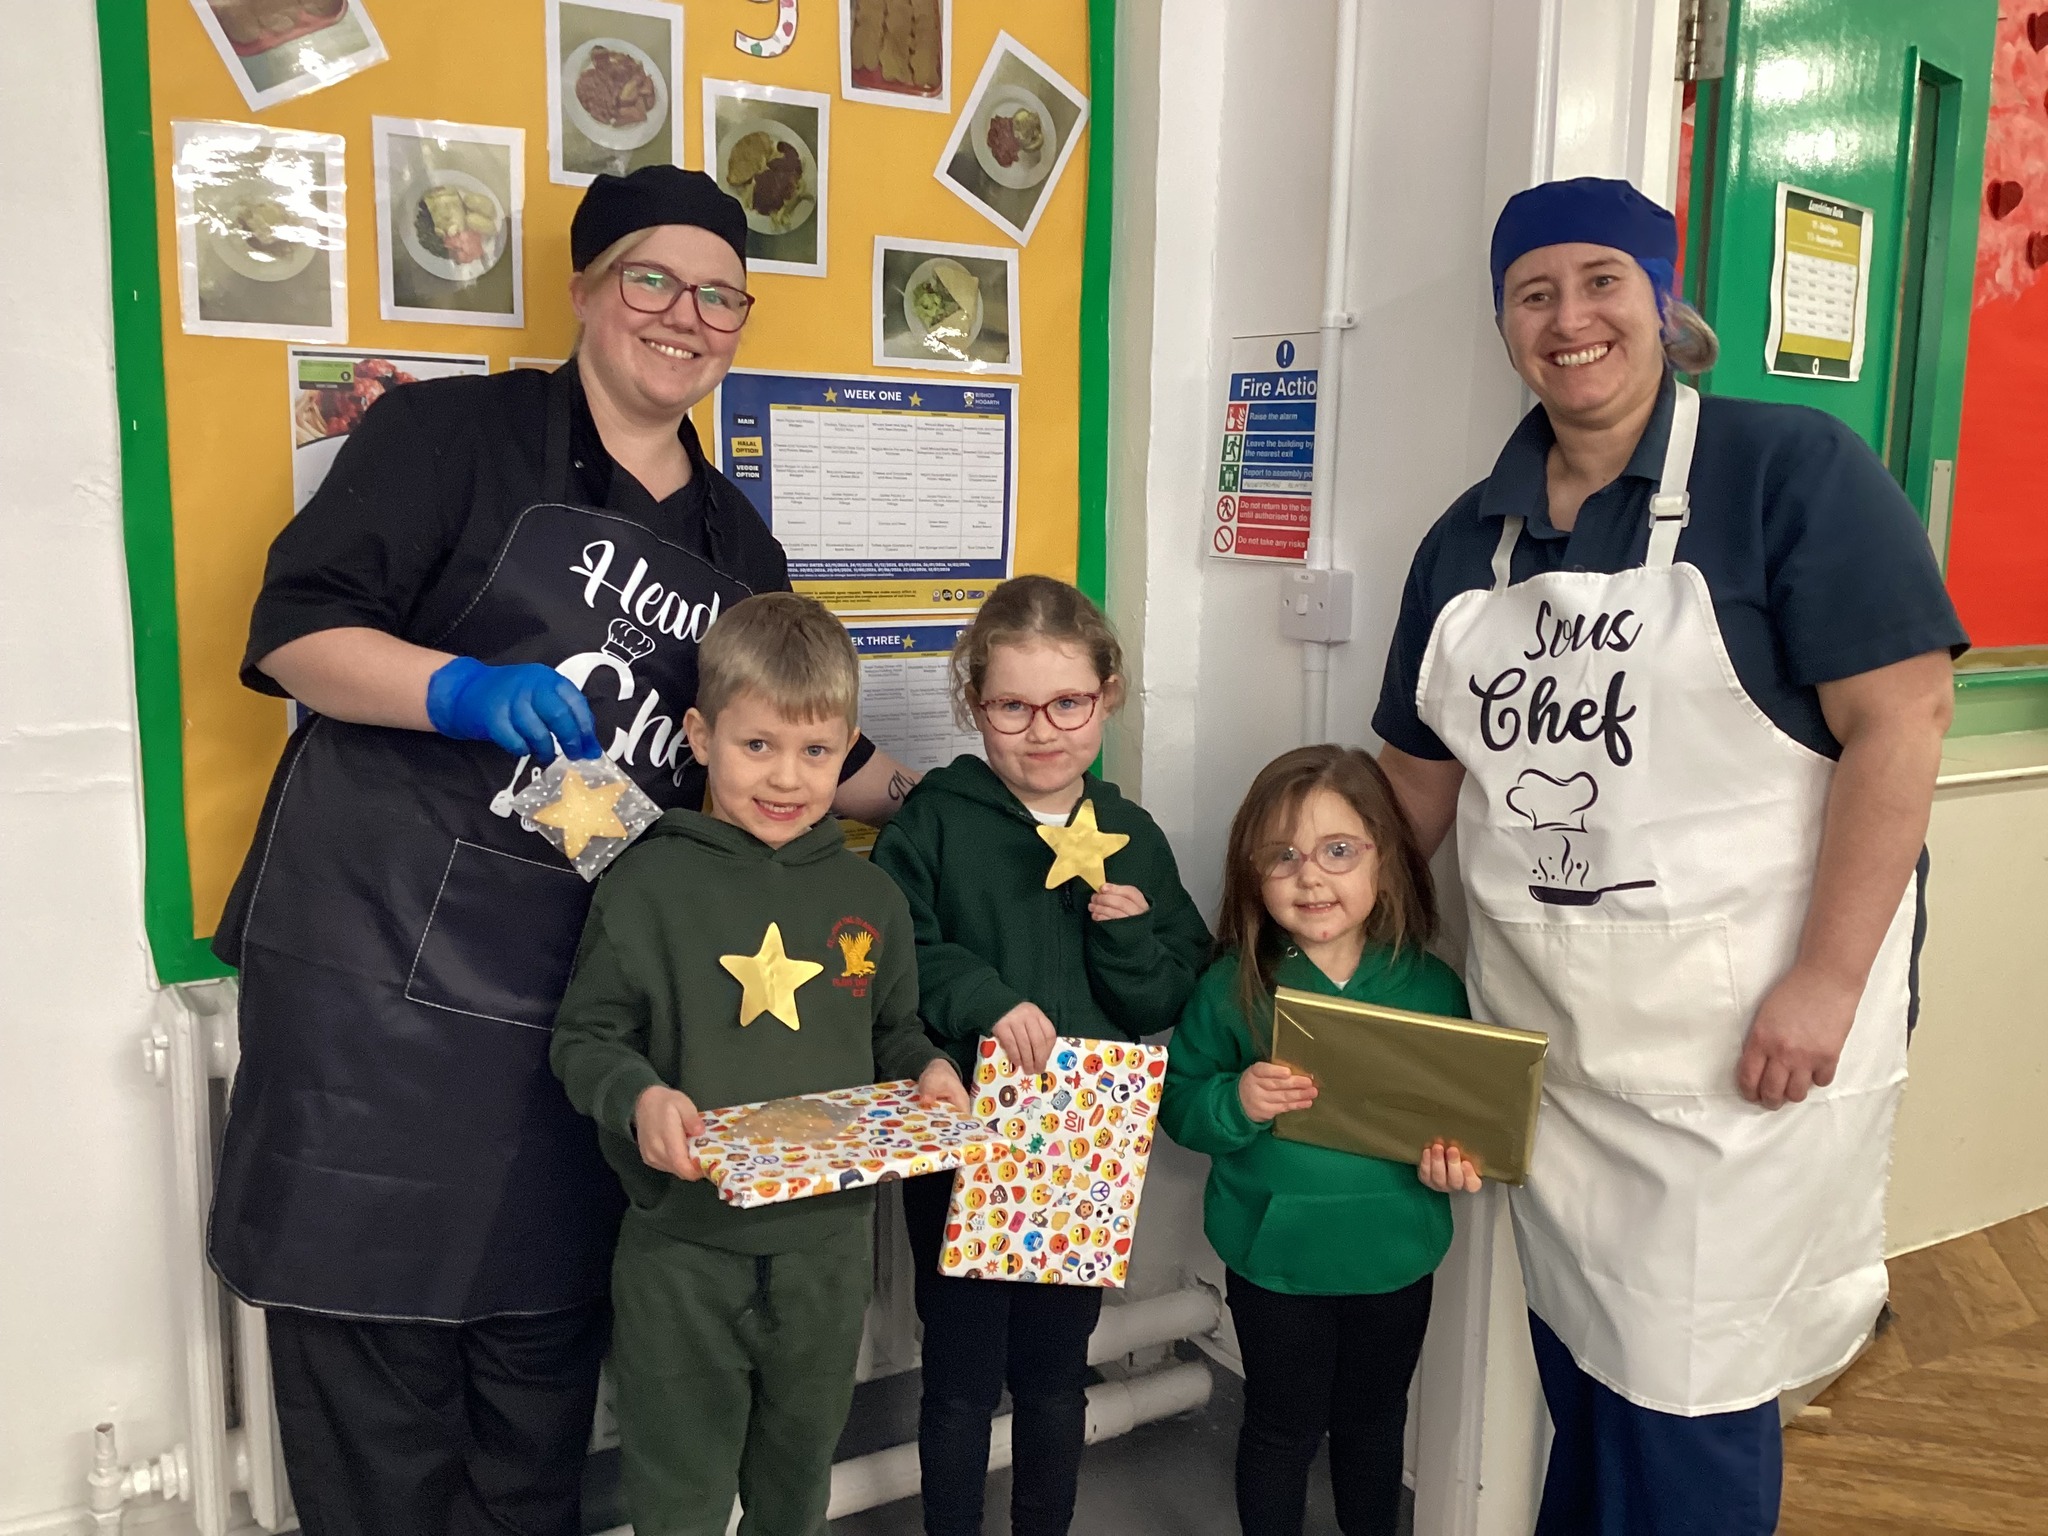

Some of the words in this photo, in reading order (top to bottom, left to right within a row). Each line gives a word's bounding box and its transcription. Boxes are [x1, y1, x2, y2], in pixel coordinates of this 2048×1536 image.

[1241, 378, 1272, 397] Fire
[1275, 376, 1317, 397] Actio
[844, 389, 876, 400] WEEK
[879, 391, 902, 401] ONE
[1249, 412, 1267, 420] Raise
[1268, 412, 1279, 420] the
[1280, 412, 1298, 420] alarm
[1277, 440, 1304, 450] building
[1305, 440, 1314, 449] by
[1245, 449, 1255, 457] the
[1281, 450, 1293, 458] exit
[1243, 468, 1264, 477] Report
[1272, 469, 1303, 479] assembly
[1240, 501, 1249, 509] Do
[1261, 502, 1280, 510] return
[1289, 503, 1299, 511] the
[1300, 504, 1310, 512] bu
[1254, 512, 1289, 521] authorised
[1237, 536, 1247, 544] Do
[1260, 538, 1273, 546] take
[1275, 540, 1287, 549] any
[1288, 539, 1305, 548] risks
[569, 539, 721, 644] Head
[1523, 600, 1643, 661] Sous
[851, 636, 865, 646] EK
[866, 635, 901, 645] THREE
[550, 652, 694, 788] Che
[1469, 667, 1637, 767] Chef
